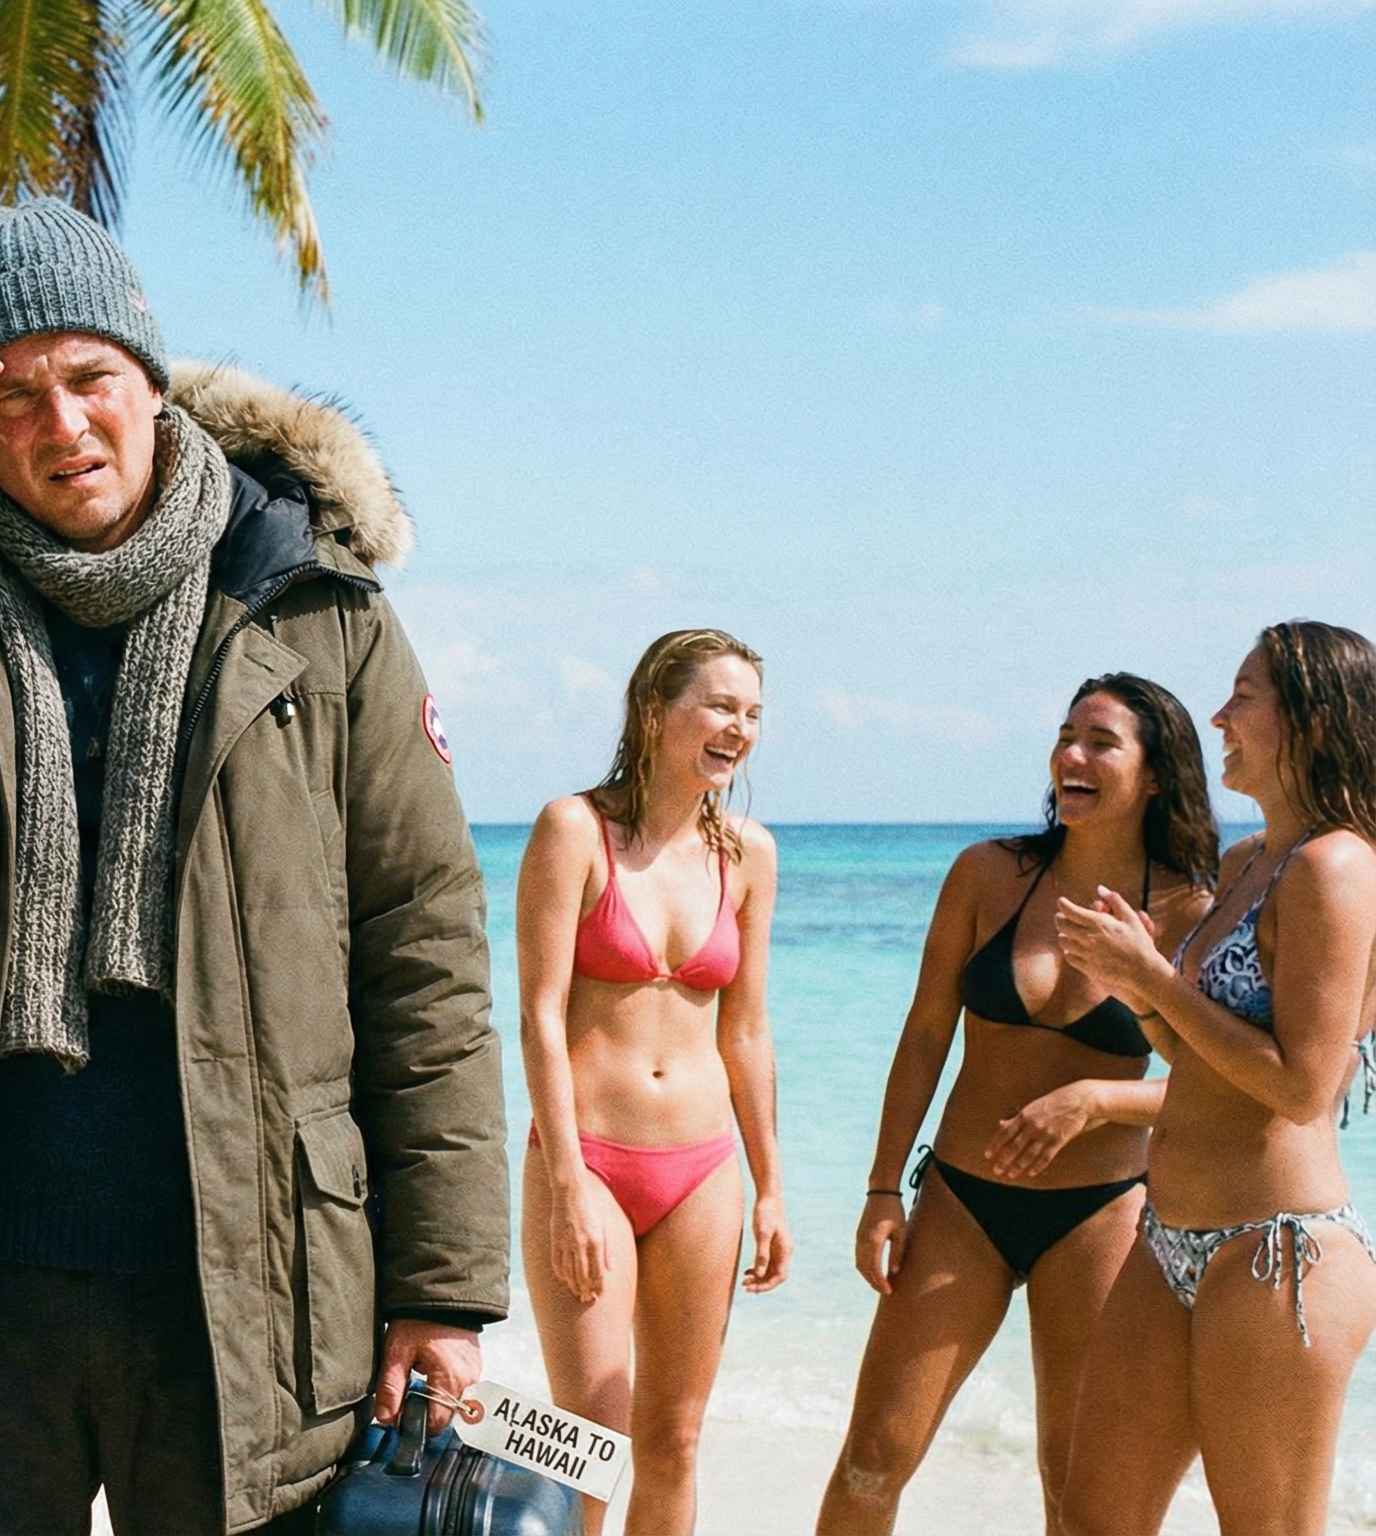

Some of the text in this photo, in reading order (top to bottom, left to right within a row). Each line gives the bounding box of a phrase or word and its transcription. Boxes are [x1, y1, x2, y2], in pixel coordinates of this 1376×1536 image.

[493, 1398, 616, 1462] ALASKA TO
[505, 1430, 587, 1480] HAWAII
